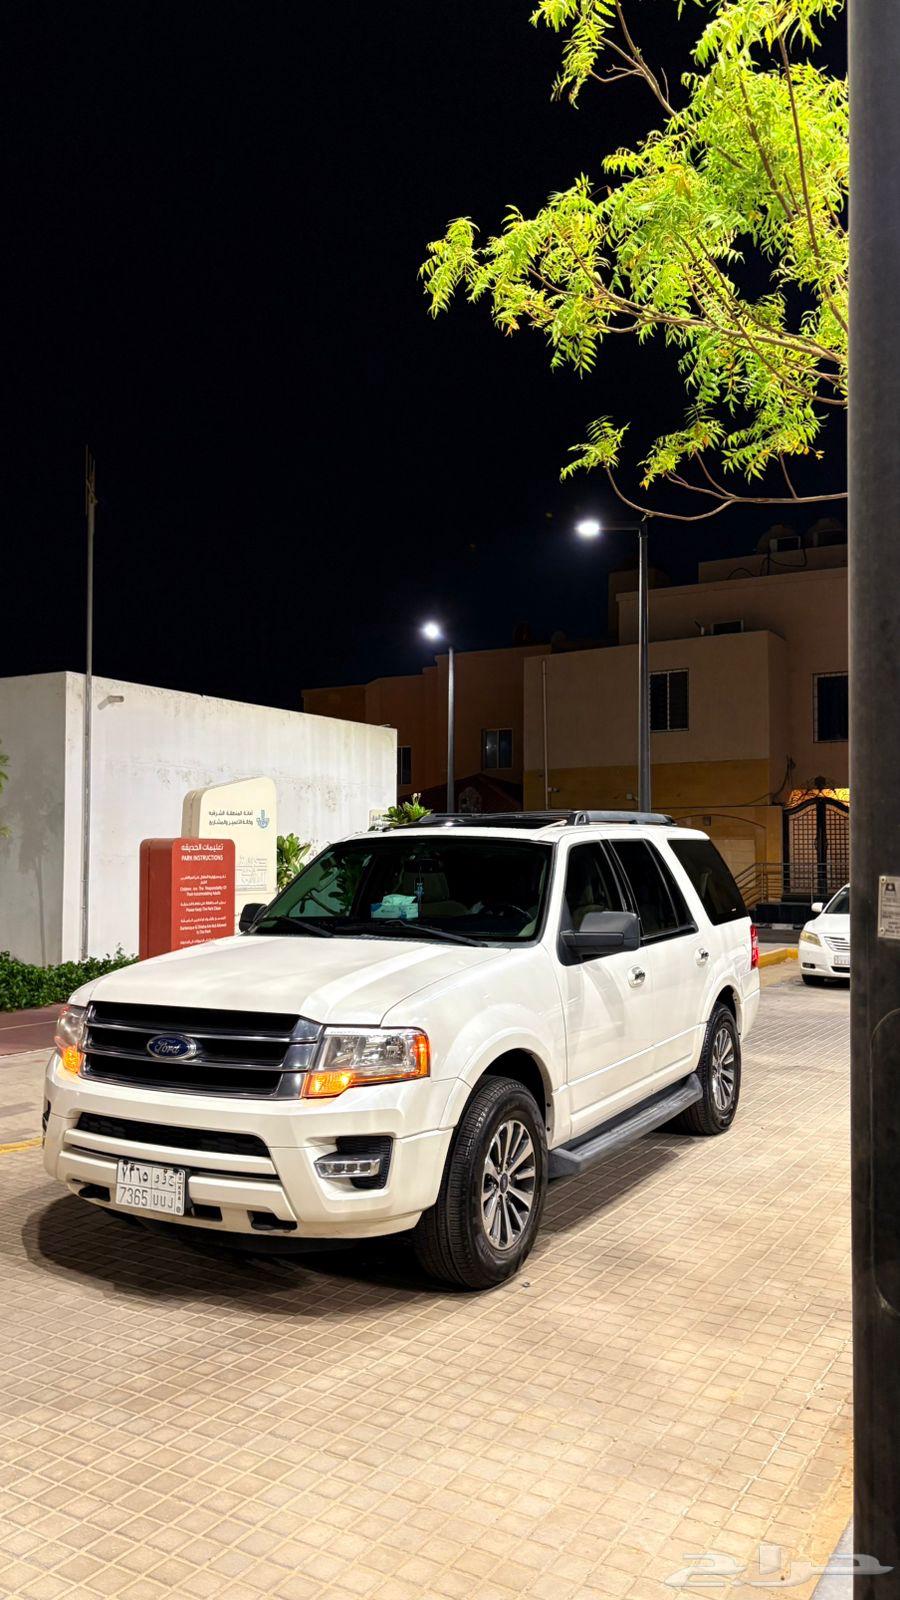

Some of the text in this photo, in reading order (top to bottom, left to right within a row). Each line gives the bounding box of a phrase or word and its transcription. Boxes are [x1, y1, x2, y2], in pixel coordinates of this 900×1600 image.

[202, 844, 224, 852] تعليمات
[155, 1040, 181, 1054] Ford
[119, 1187, 174, 1208] 7365 UUJ
